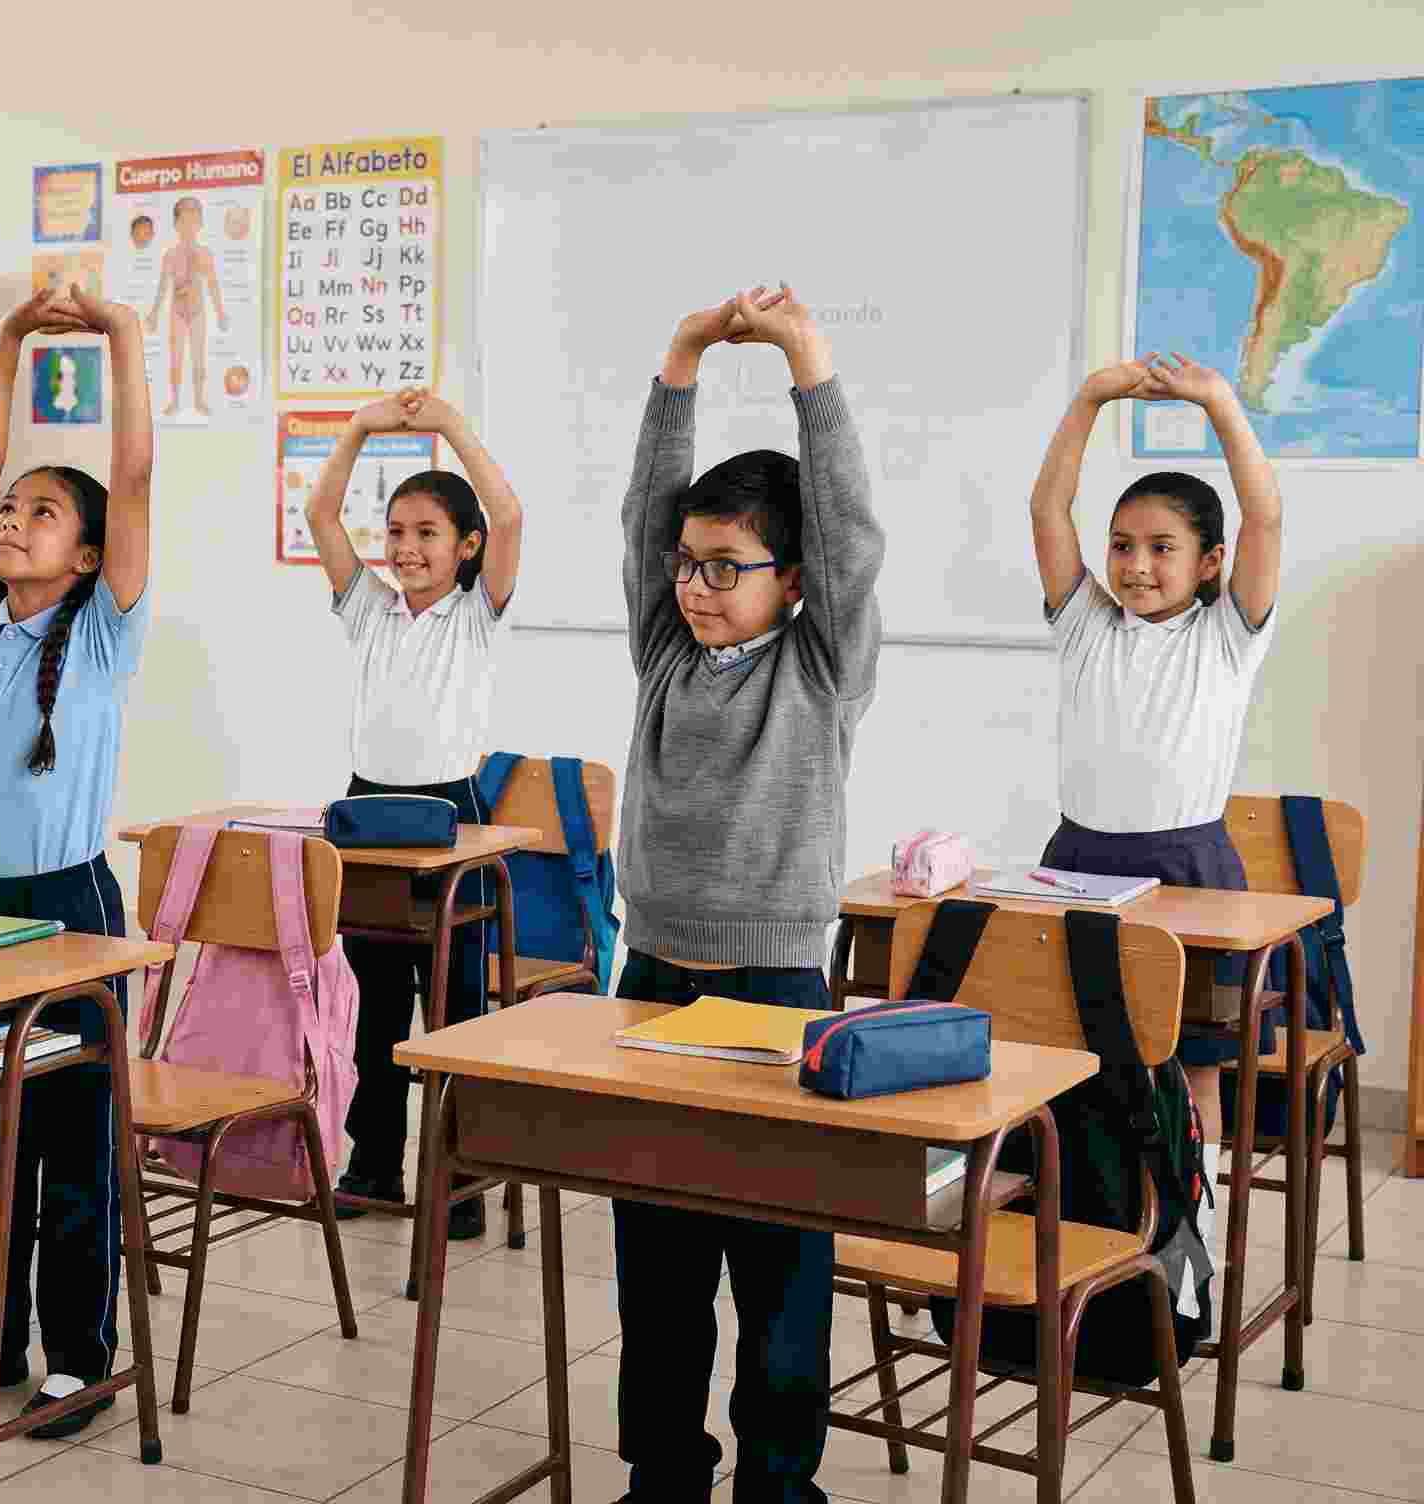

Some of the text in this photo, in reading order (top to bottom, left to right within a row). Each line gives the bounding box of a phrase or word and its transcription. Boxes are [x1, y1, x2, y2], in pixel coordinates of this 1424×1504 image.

[293, 145, 427, 176] El Alfabeto
[120, 161, 260, 188] Cuerpo Humano
[290, 186, 427, 211] Aa Bb Cc Dd
[288, 216, 425, 242] Ee Ff Gg Hh
[399, 245, 425, 265] Kk
[320, 279, 353, 296] Mm
[361, 277, 388, 295] Nn
[399, 275, 426, 299] Pp
[326, 306, 349, 325] Rr
[362, 304, 385, 323] Ss
[400, 303, 425, 323] Tt
[288, 332, 425, 354] Uu Vv Ww Xx
[360, 361, 386, 386] Yy
[399, 360, 425, 380] Zz
